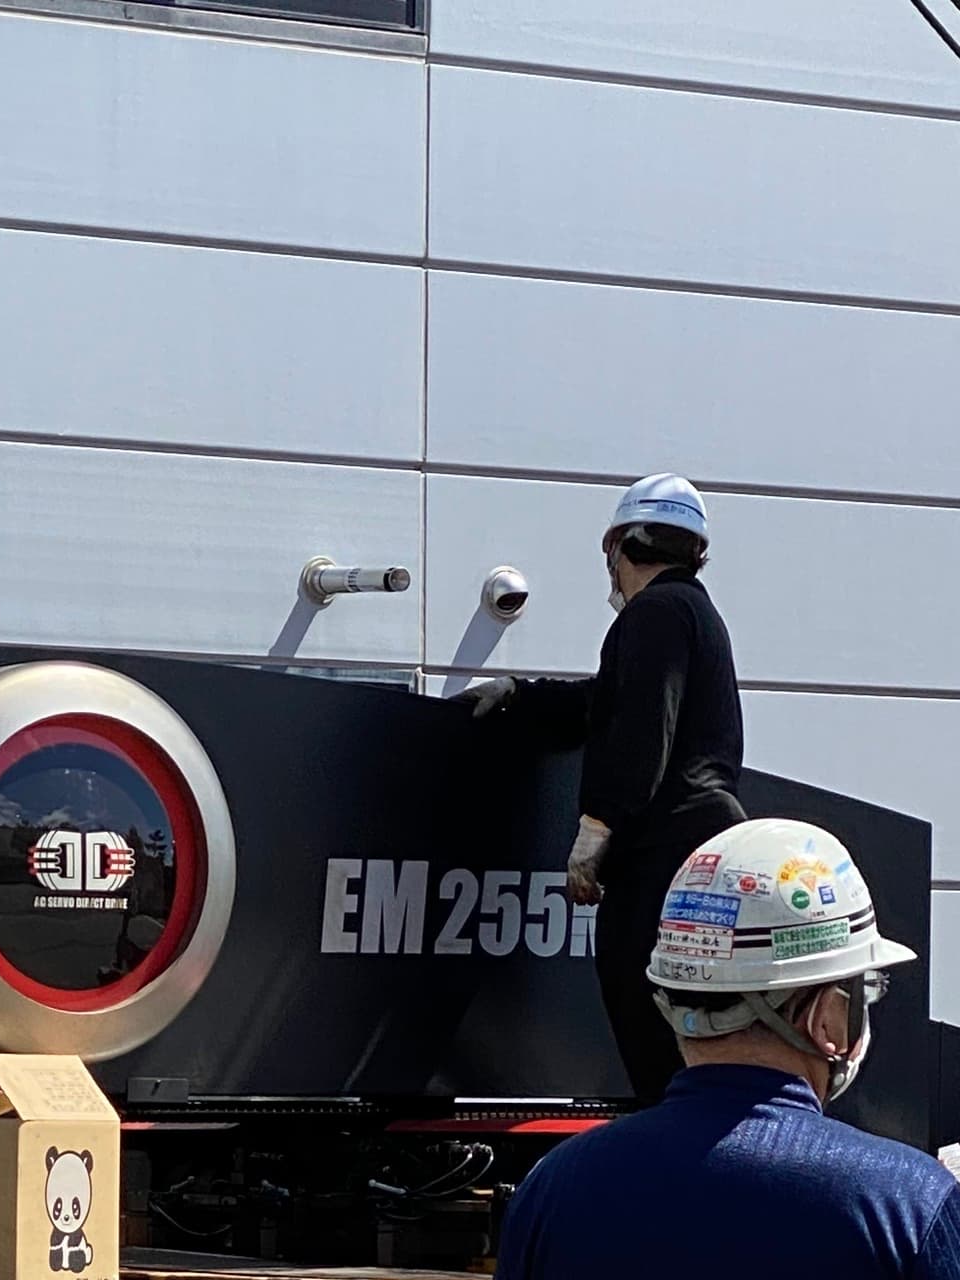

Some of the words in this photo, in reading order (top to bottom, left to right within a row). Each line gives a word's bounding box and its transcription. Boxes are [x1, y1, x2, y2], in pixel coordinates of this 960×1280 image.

[34, 895, 46, 908] AC
[47, 896, 74, 908] SERVO
[321, 858, 429, 954] EM
[663, 961, 713, 980] こばやし
